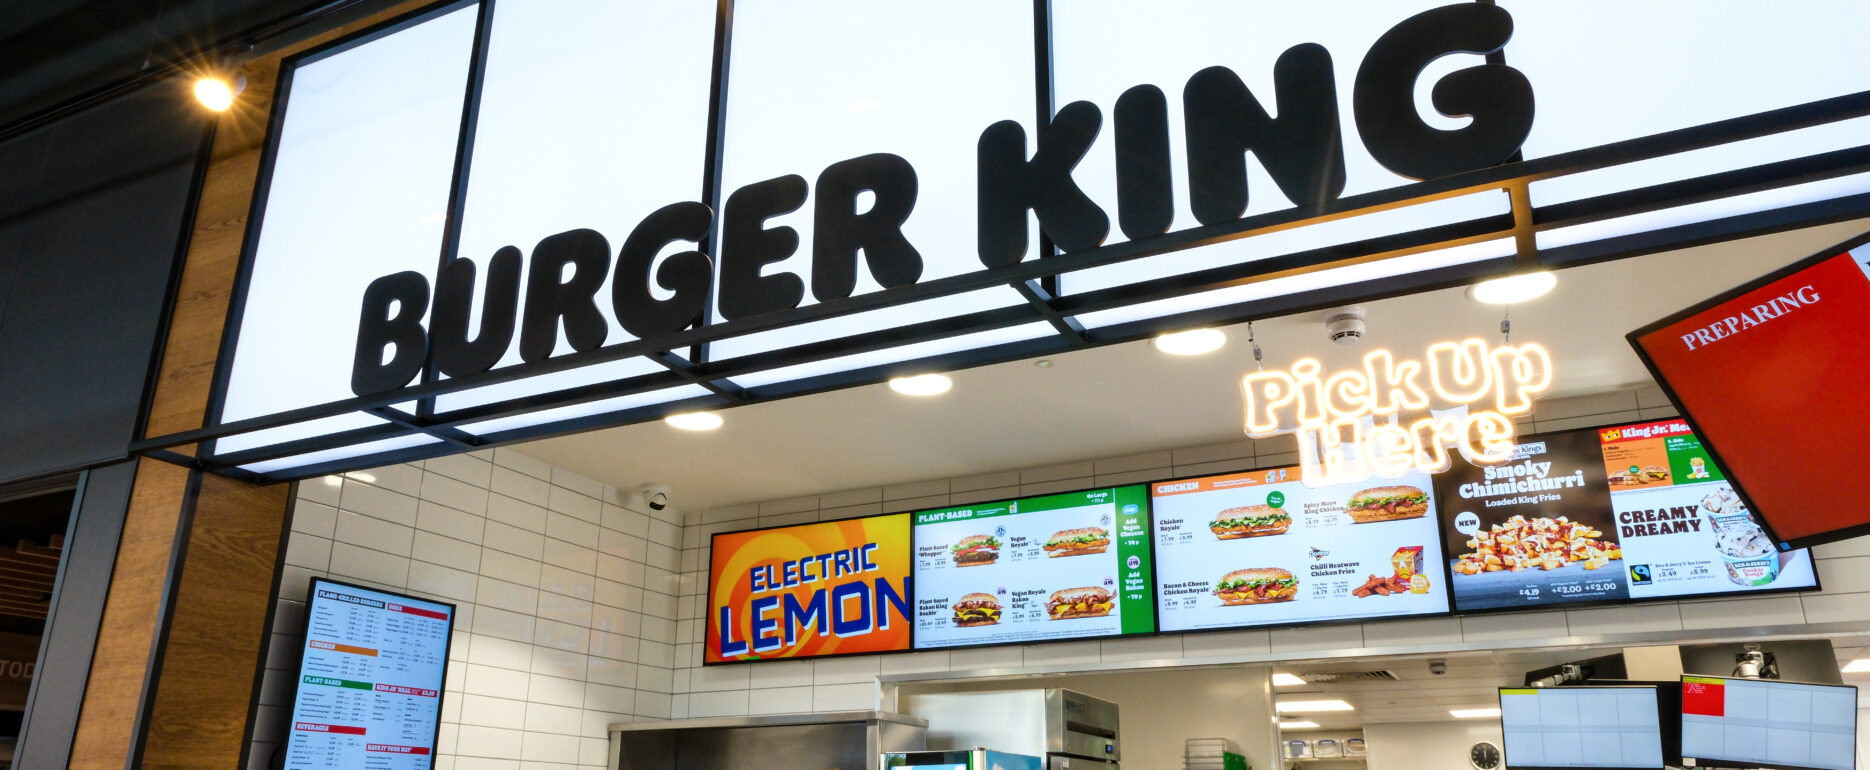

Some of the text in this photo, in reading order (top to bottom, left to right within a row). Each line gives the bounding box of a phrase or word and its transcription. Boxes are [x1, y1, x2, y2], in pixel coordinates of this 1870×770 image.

[351, 2, 1535, 396] BURGER KING
[1681, 285, 1822, 352] PREPARING
[1242, 338, 1553, 434] Pick Up
[1622, 426, 1651, 438] King
[1297, 411, 1517, 484] Here
[1520, 444, 1542, 454] Kings
[1484, 460, 1552, 480] Smoky
[1157, 481, 1199, 494] CHICKEN
[1459, 470, 1586, 499] Chimichurri
[1485, 493, 1561, 508] Loaded King Fries
[919, 510, 973, 523] PLANT-BASED
[1458, 519, 1477, 527] NEW
[1619, 505, 1699, 525] CREAMY
[1621, 519, 1702, 539] DREAMY
[751, 542, 880, 594] ELECTRIC
[1310, 561, 1360, 571] Chilli Heatwave
[1163, 588, 1188, 596] Chicken
[1519, 588, 1540, 597] £4.19
[720, 575, 911, 658] LEMON
